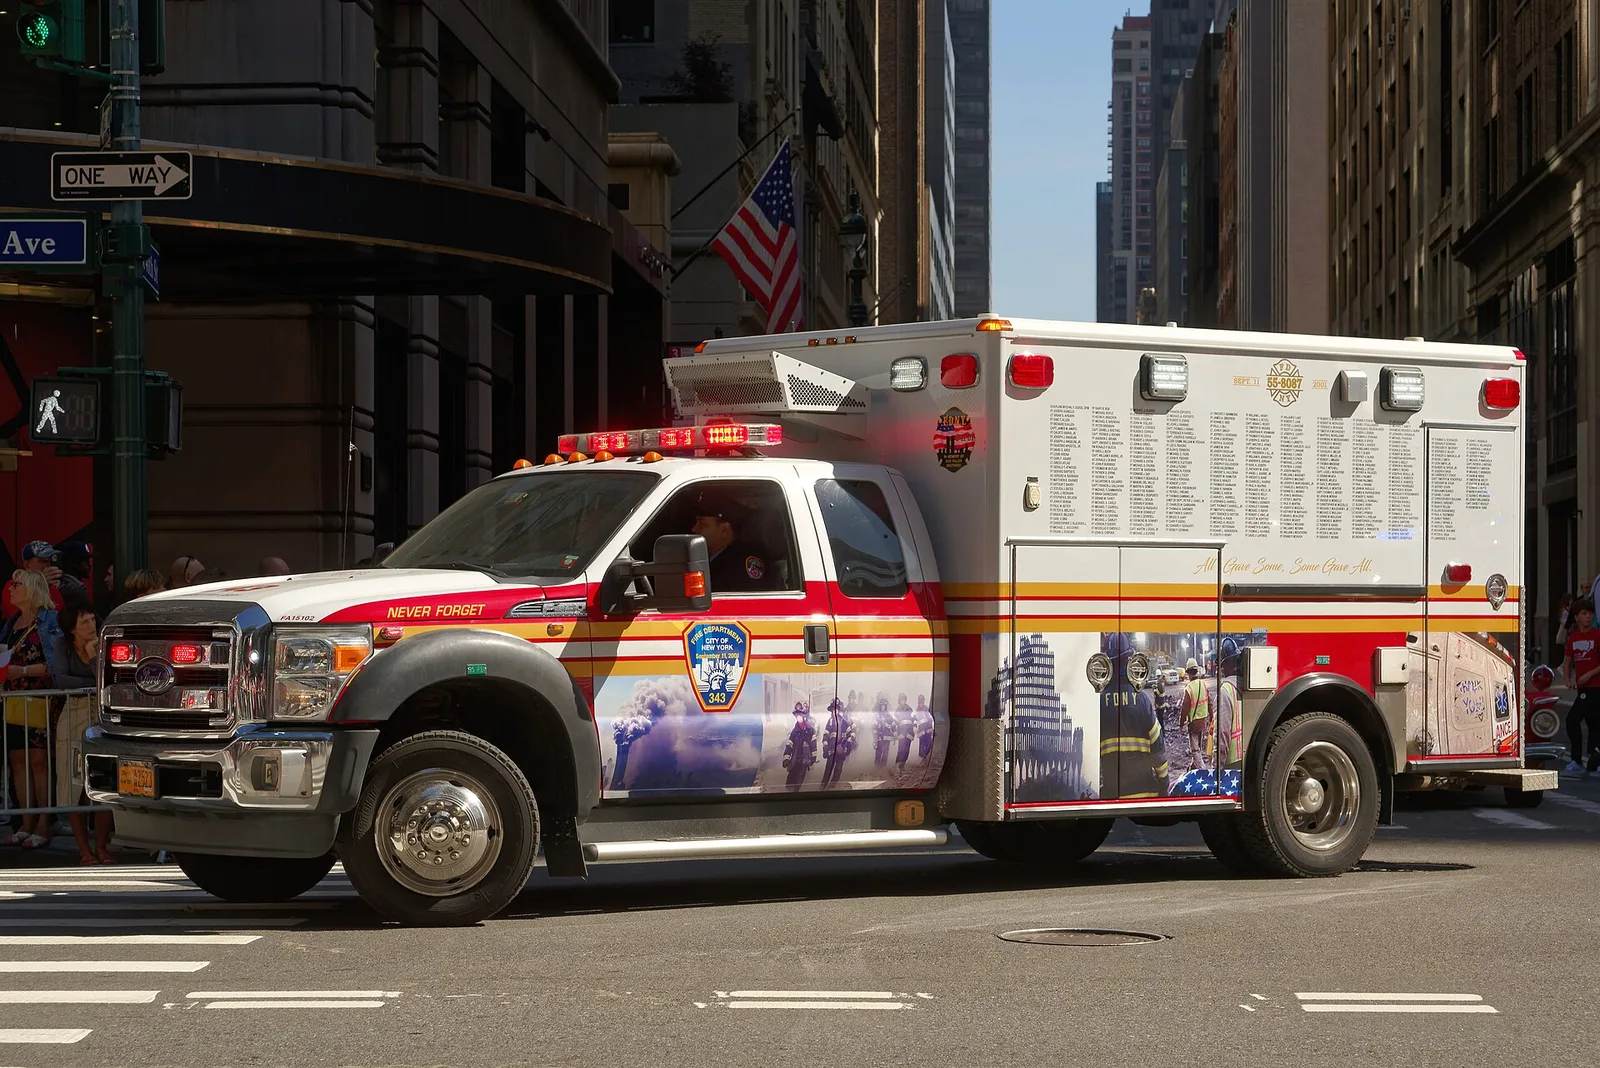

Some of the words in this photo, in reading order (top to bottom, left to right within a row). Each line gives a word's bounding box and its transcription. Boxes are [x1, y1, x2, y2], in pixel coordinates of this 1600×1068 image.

[65, 167, 105, 185] ONE
[129, 167, 172, 184] WAY
[2, 230, 56, 255] Ave
[1267, 376, 1302, 390] 55-8087
[1192, 556, 1217, 575] All
[1223, 557, 1249, 575] Gave
[1289, 557, 1320, 575] Some
[1321, 557, 1349, 576] Gave
[386, 605, 431, 619] NEVER
[435, 604, 486, 617] FORGET
[690, 630, 704, 645] FIRE
[703, 626, 743, 644] DEPARTMENT
[708, 692, 726, 704] 343
[1105, 692, 1137, 706] FDNY
